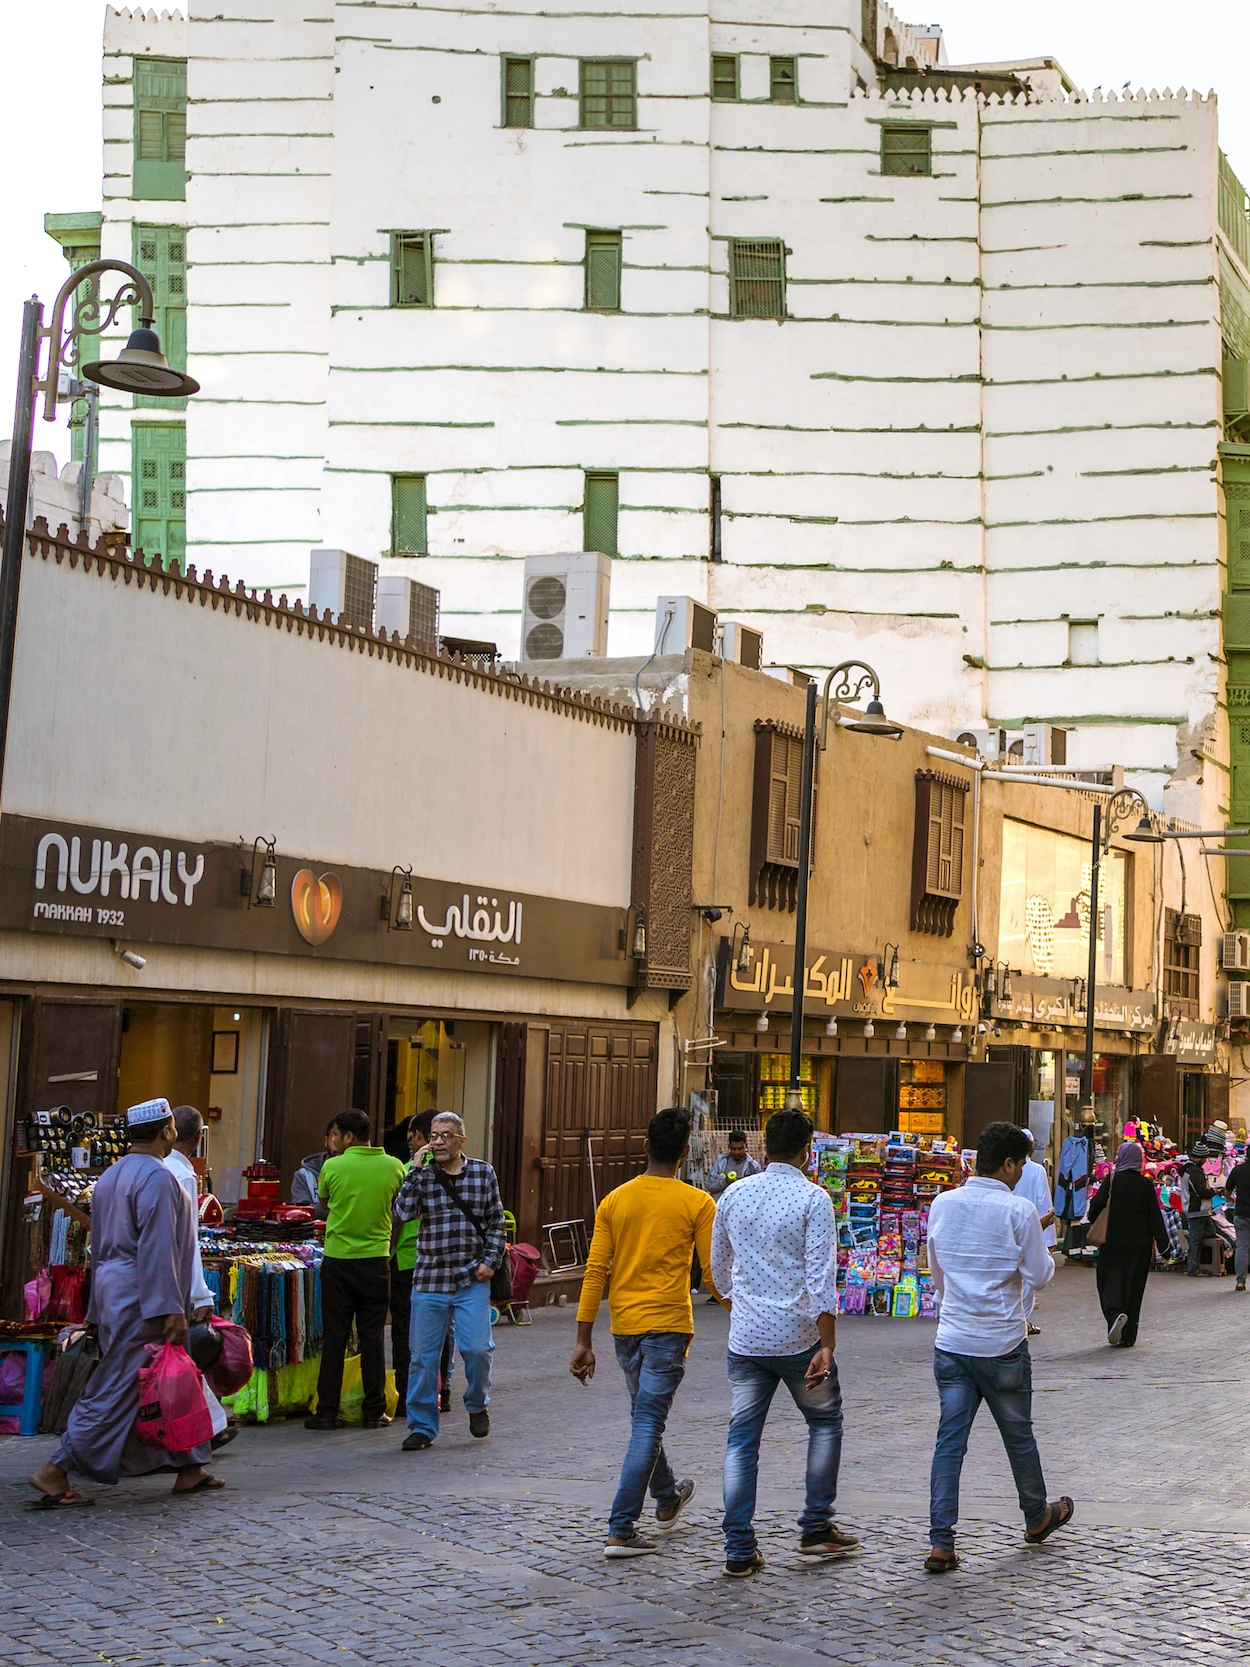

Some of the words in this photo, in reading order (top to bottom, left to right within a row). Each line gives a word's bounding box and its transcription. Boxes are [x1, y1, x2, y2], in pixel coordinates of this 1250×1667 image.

[35, 832, 205, 907] NUKALY
[33, 902, 93, 923] MAKKAH
[97, 908, 125, 926] 1932
[417, 894, 523, 949] النقلي
[488, 950, 520, 966] مكة
[1034, 996, 1071, 1021] الكبرى
[1129, 1005, 1154, 1029] مركز
